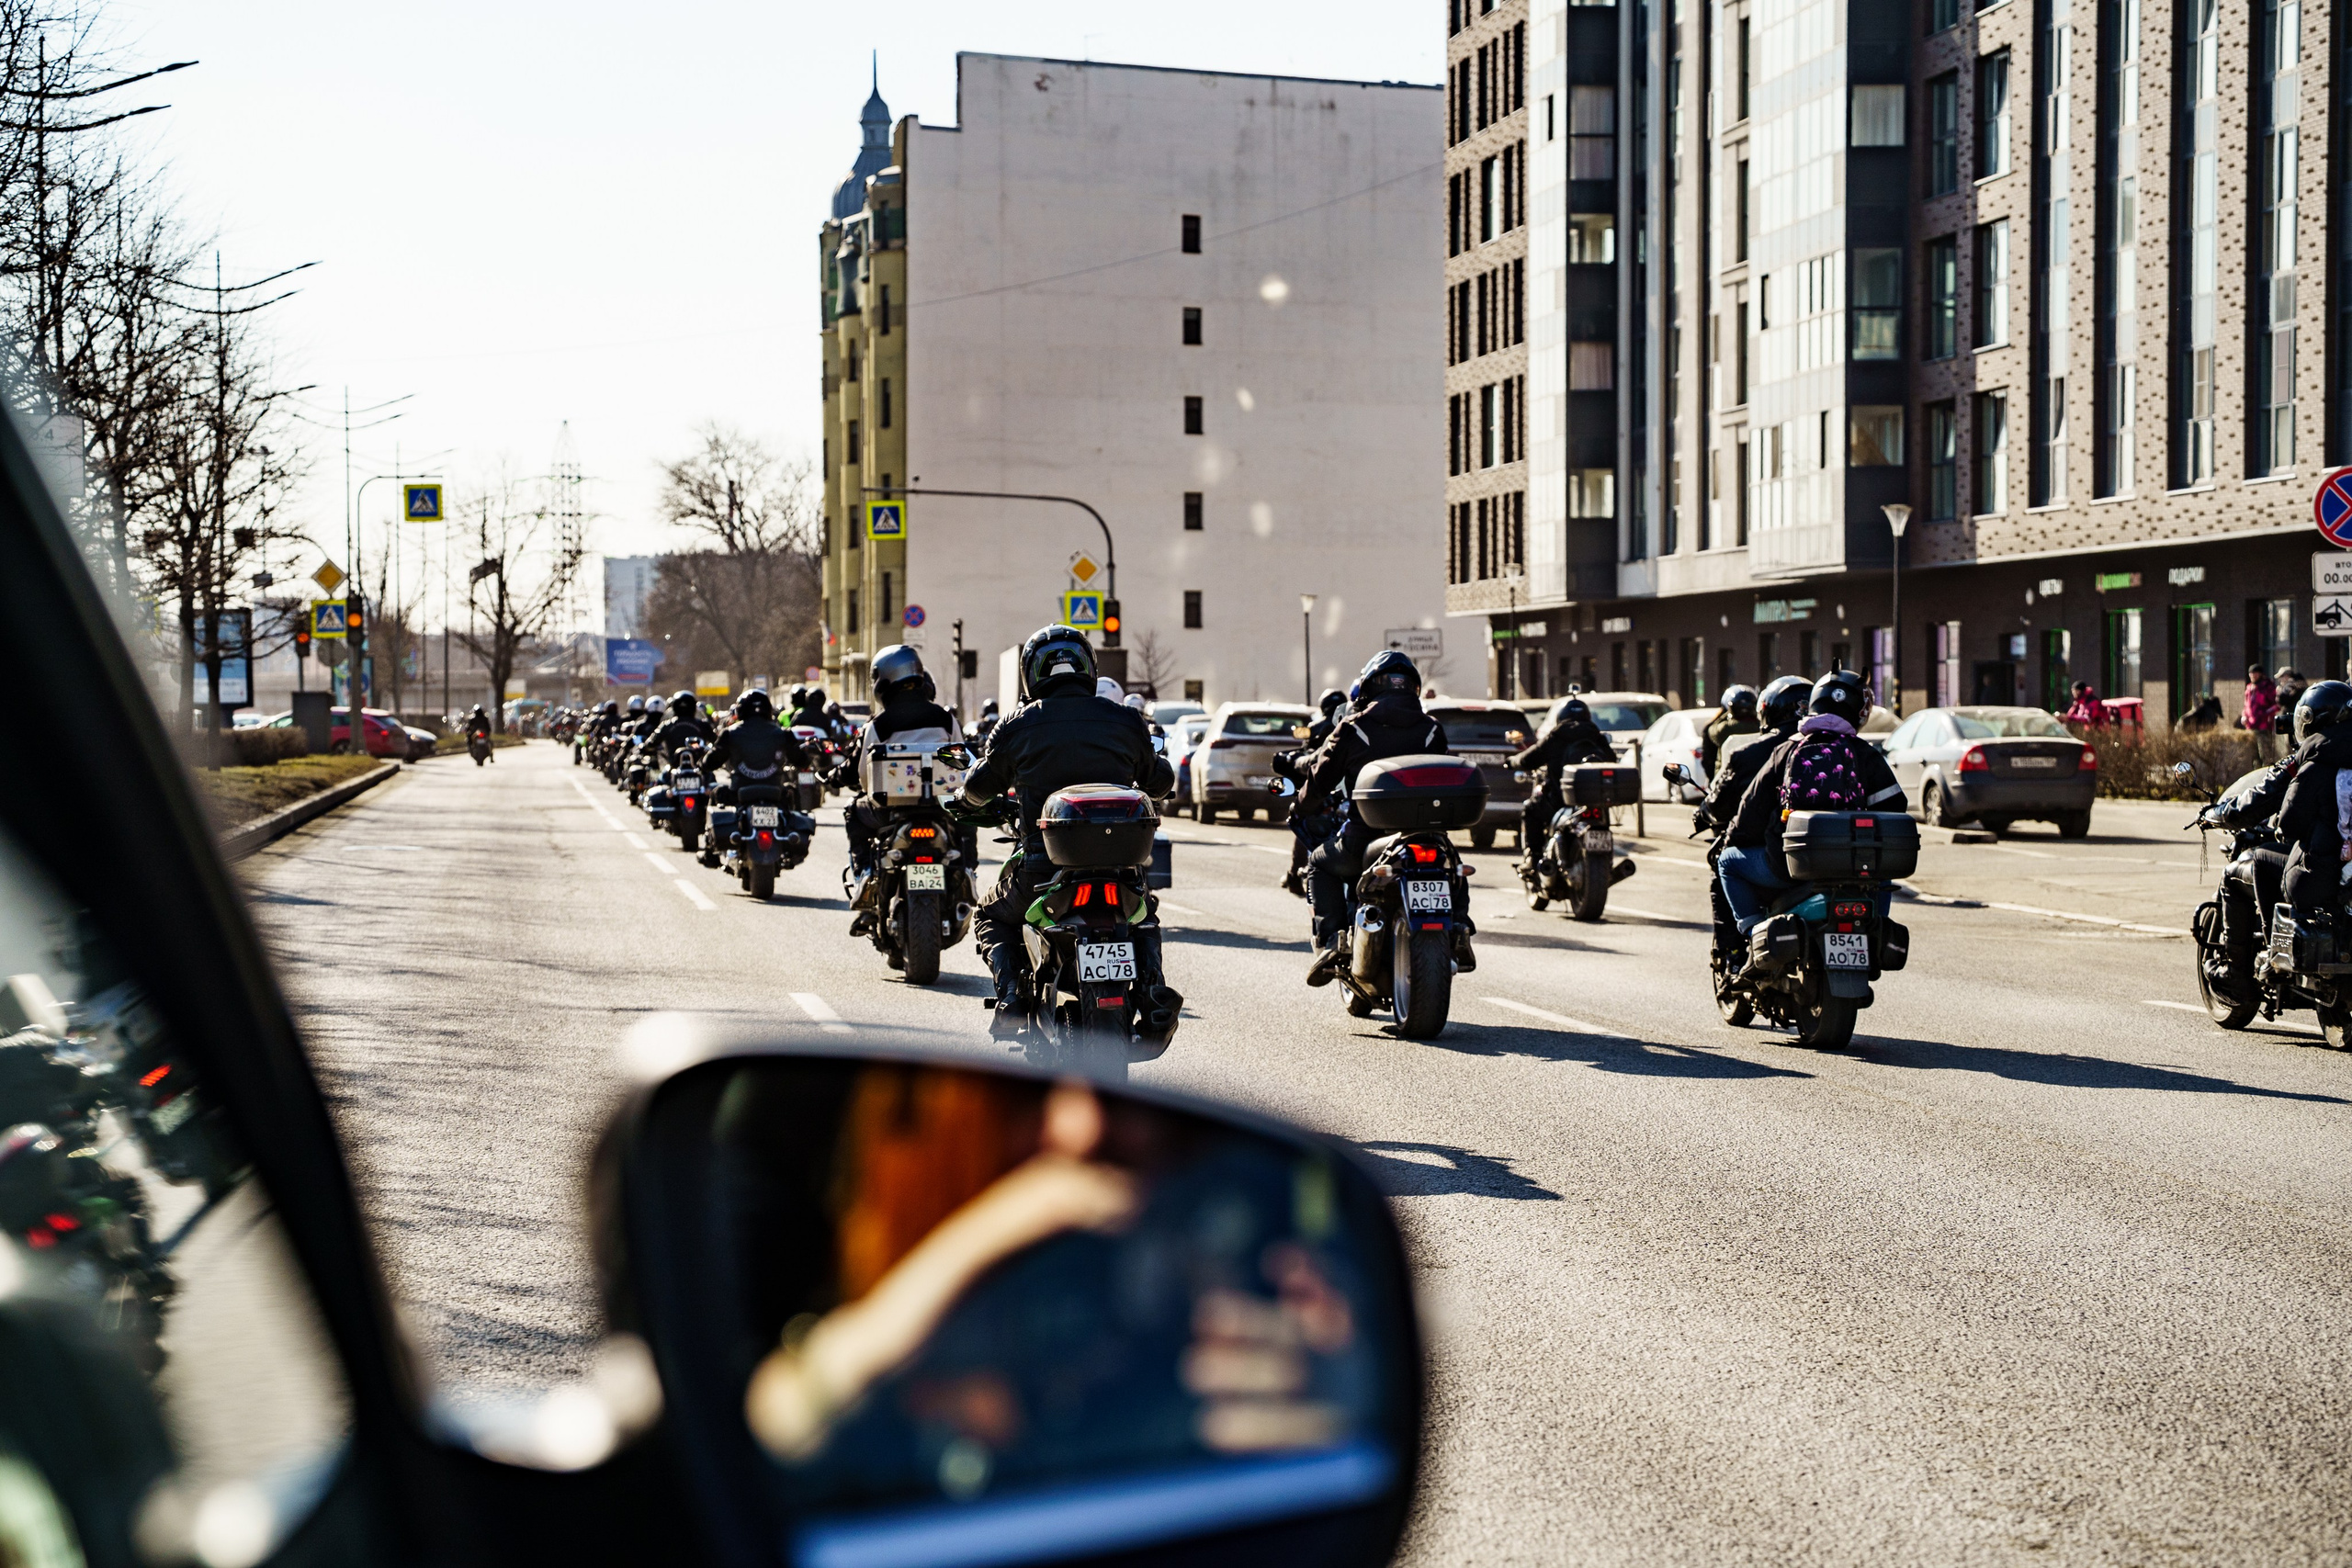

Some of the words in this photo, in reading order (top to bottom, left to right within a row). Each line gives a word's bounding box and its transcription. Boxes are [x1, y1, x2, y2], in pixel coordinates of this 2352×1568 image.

[912, 866, 938, 874] 3046
[1412, 882, 1443, 892] 8307
[1433, 897, 1449, 908] 78
[1830, 935, 1862, 947] 8541
[1085, 944, 1126, 958] 4745
[1850, 953, 1867, 964] 78
[1113, 964, 1133, 977] 78
